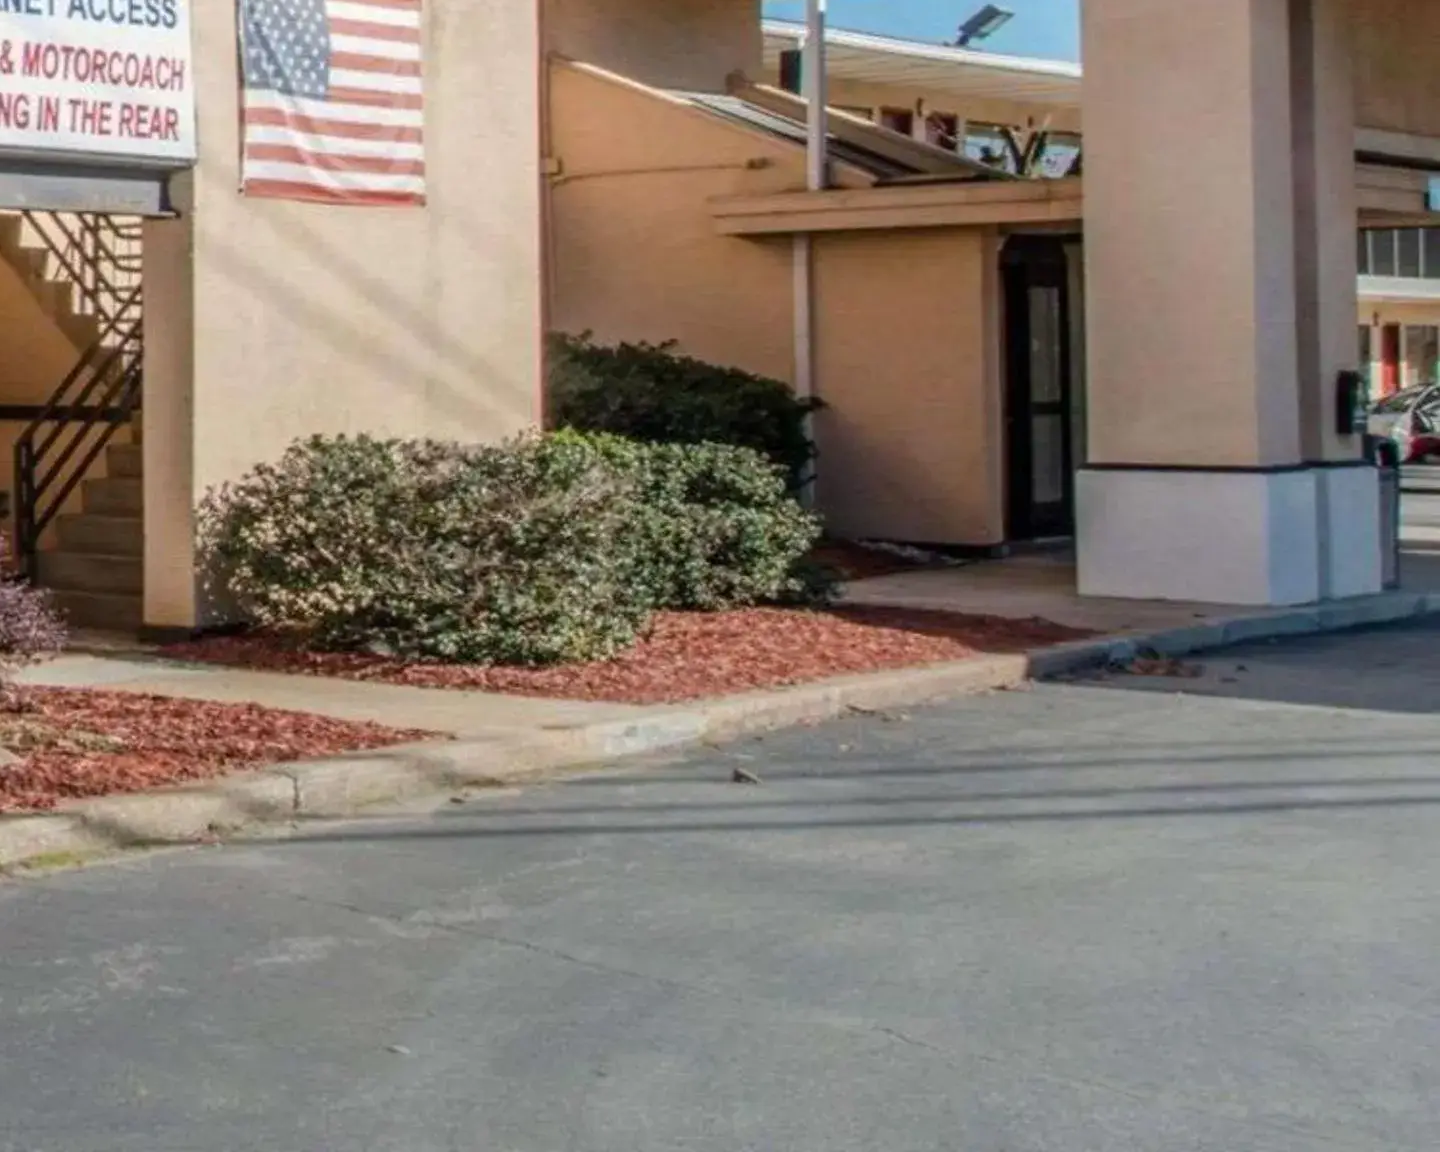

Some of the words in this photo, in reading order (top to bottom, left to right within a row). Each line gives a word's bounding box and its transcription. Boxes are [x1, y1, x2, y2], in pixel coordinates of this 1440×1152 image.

[0, 39, 15, 74] &
[21, 41, 185, 91] MOTORCOACH
[36, 95, 60, 132] IN
[68, 99, 112, 136] THE
[119, 103, 180, 141] REAR
